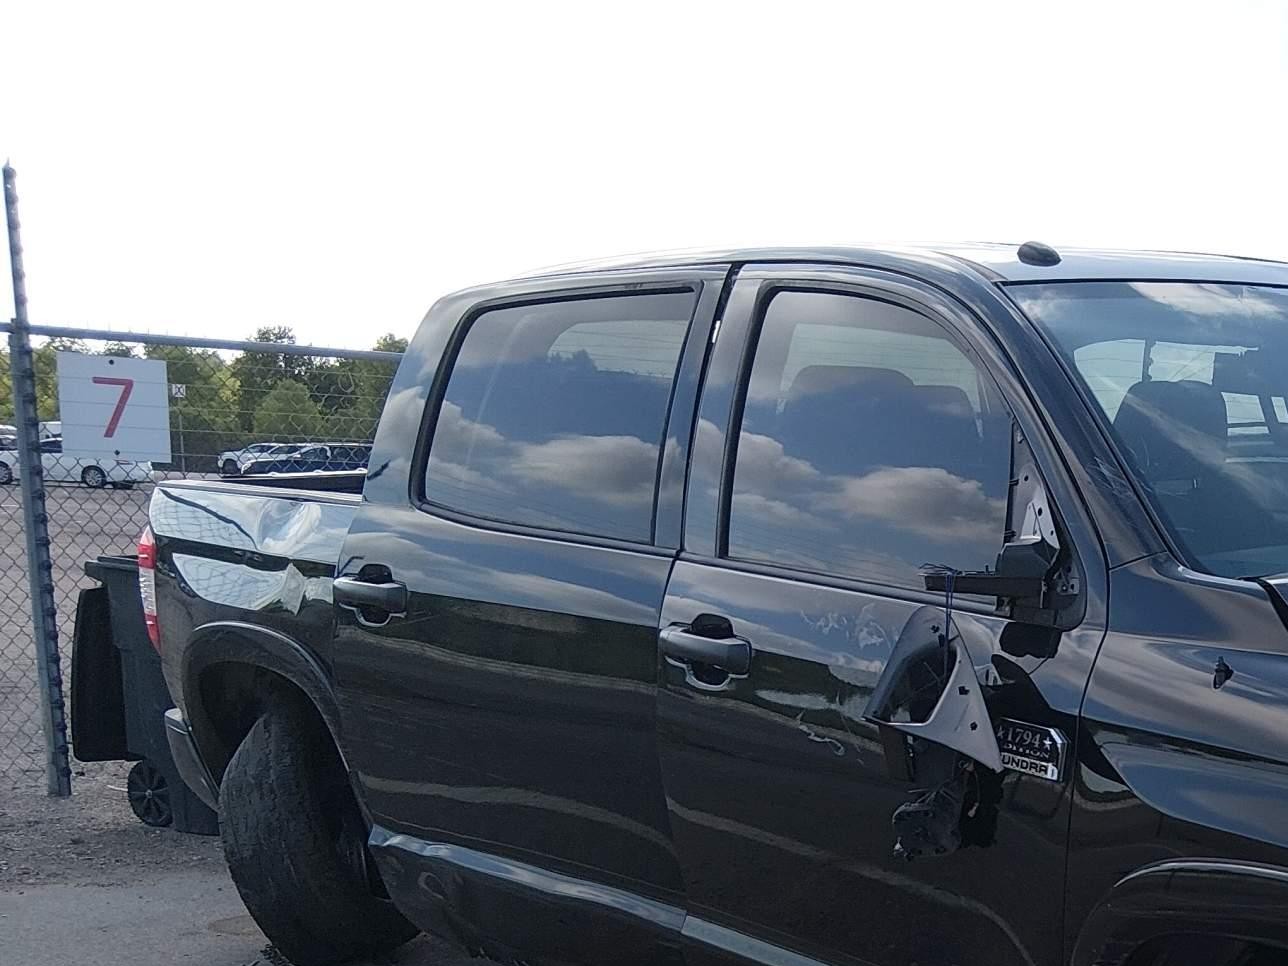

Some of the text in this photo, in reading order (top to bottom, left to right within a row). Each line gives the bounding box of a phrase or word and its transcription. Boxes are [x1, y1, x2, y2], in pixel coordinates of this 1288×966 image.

[92, 376, 134, 438] 7
[1007, 727, 1041, 748] 1794
[1001, 755, 1049, 775] UNDRA
